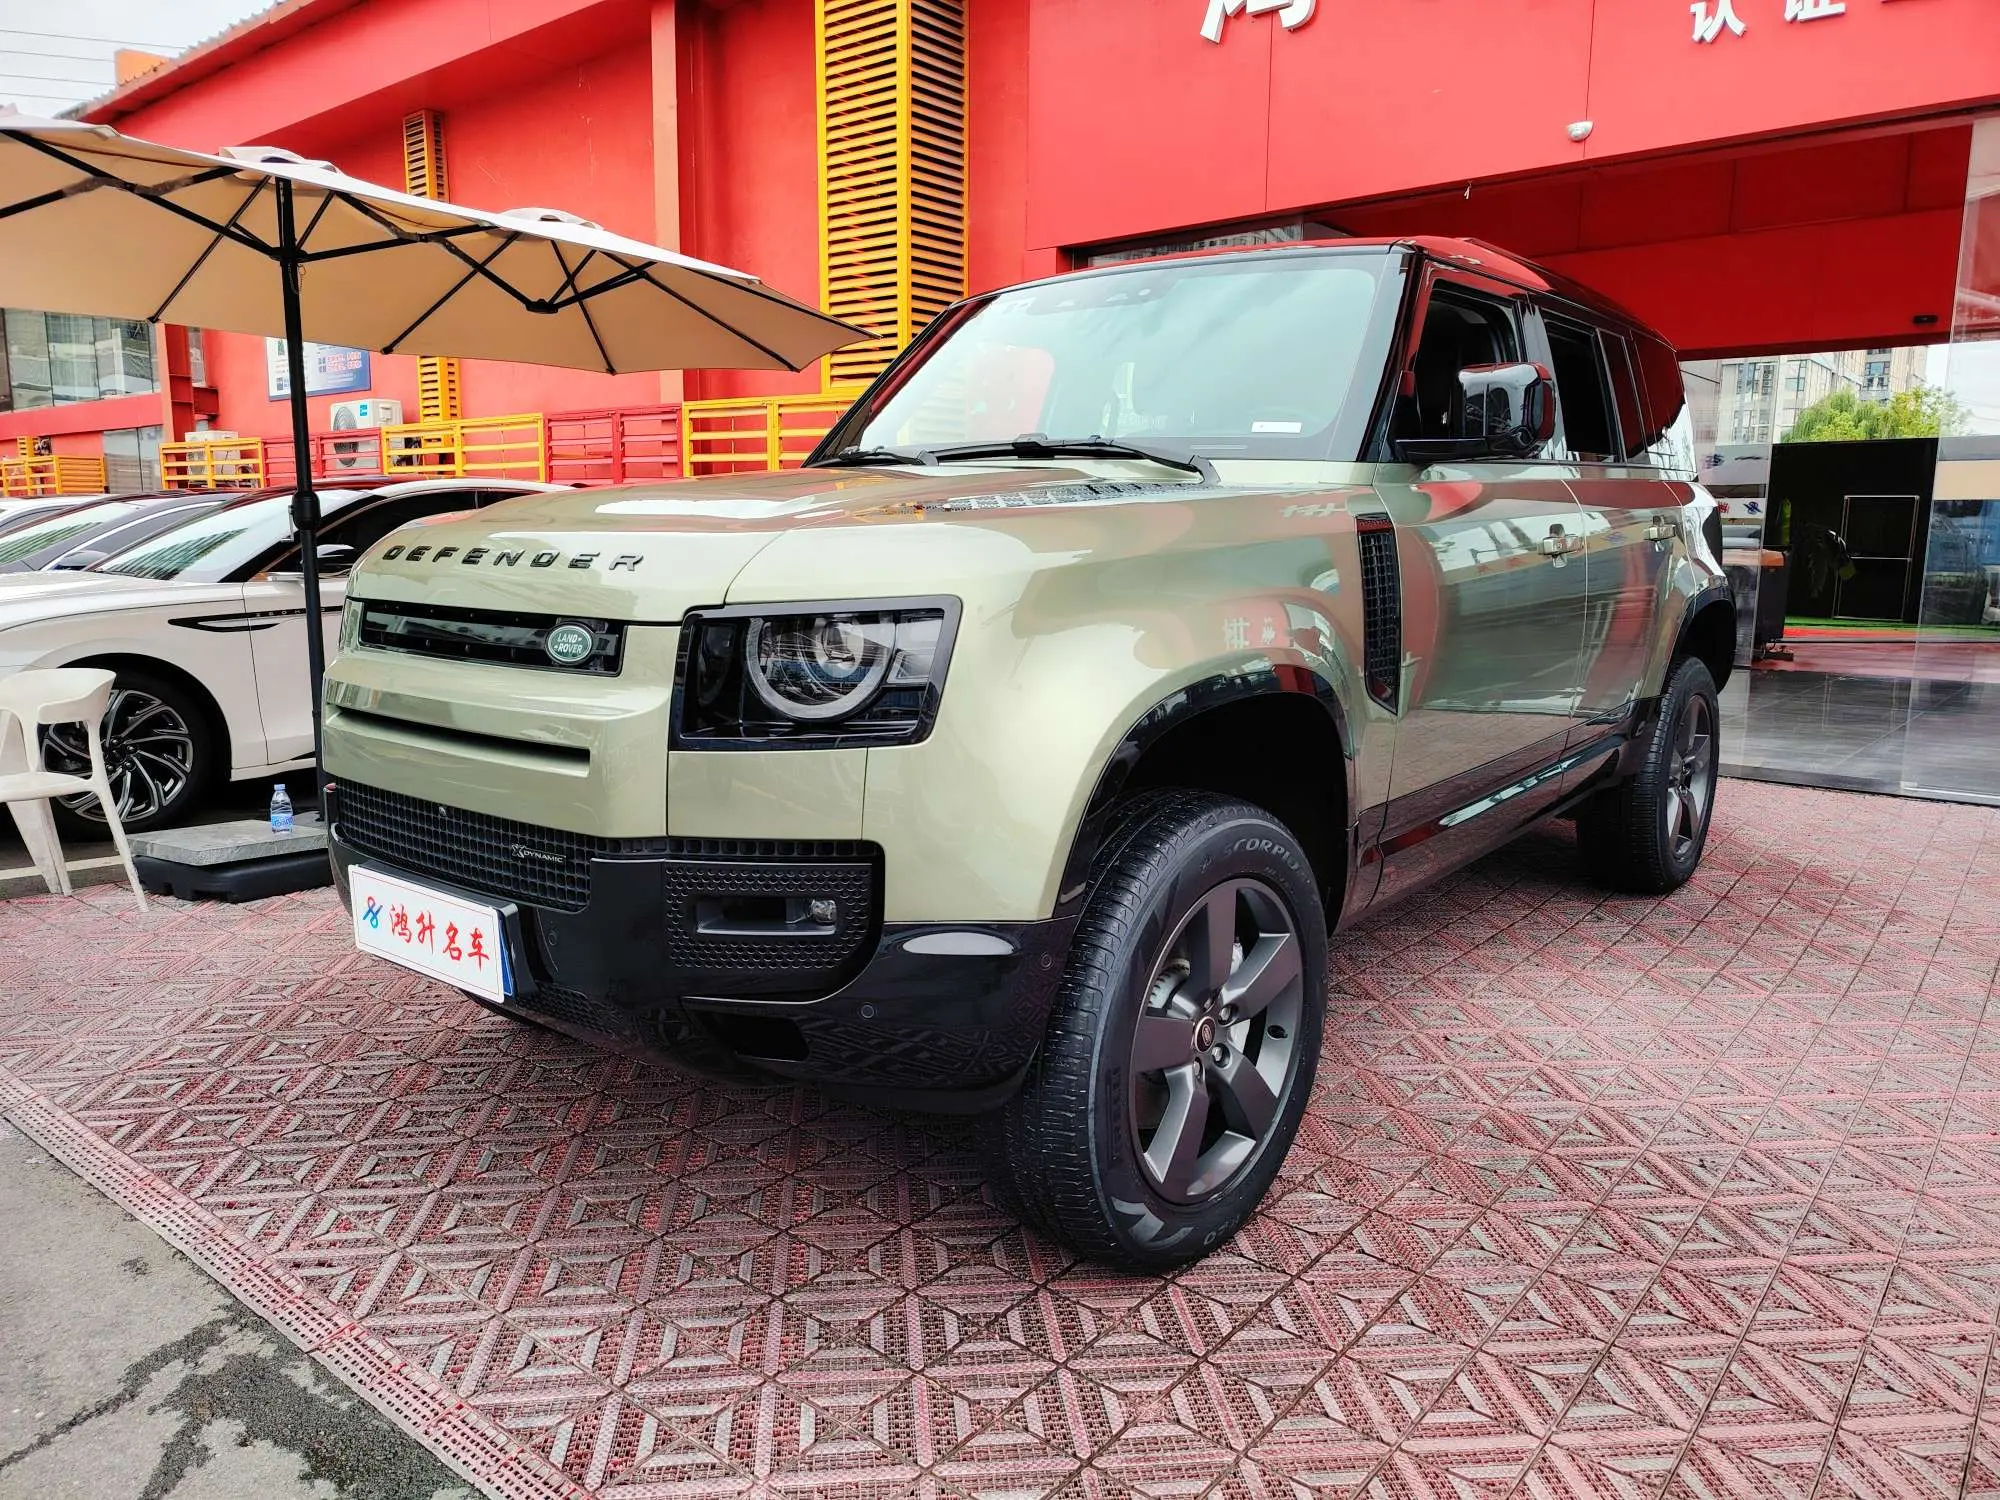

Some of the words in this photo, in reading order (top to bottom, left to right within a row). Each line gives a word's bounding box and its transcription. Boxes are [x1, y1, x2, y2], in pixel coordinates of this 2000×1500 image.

[382, 545, 644, 571] DEFENDER
[389, 903, 490, 972] 鸿升名车
